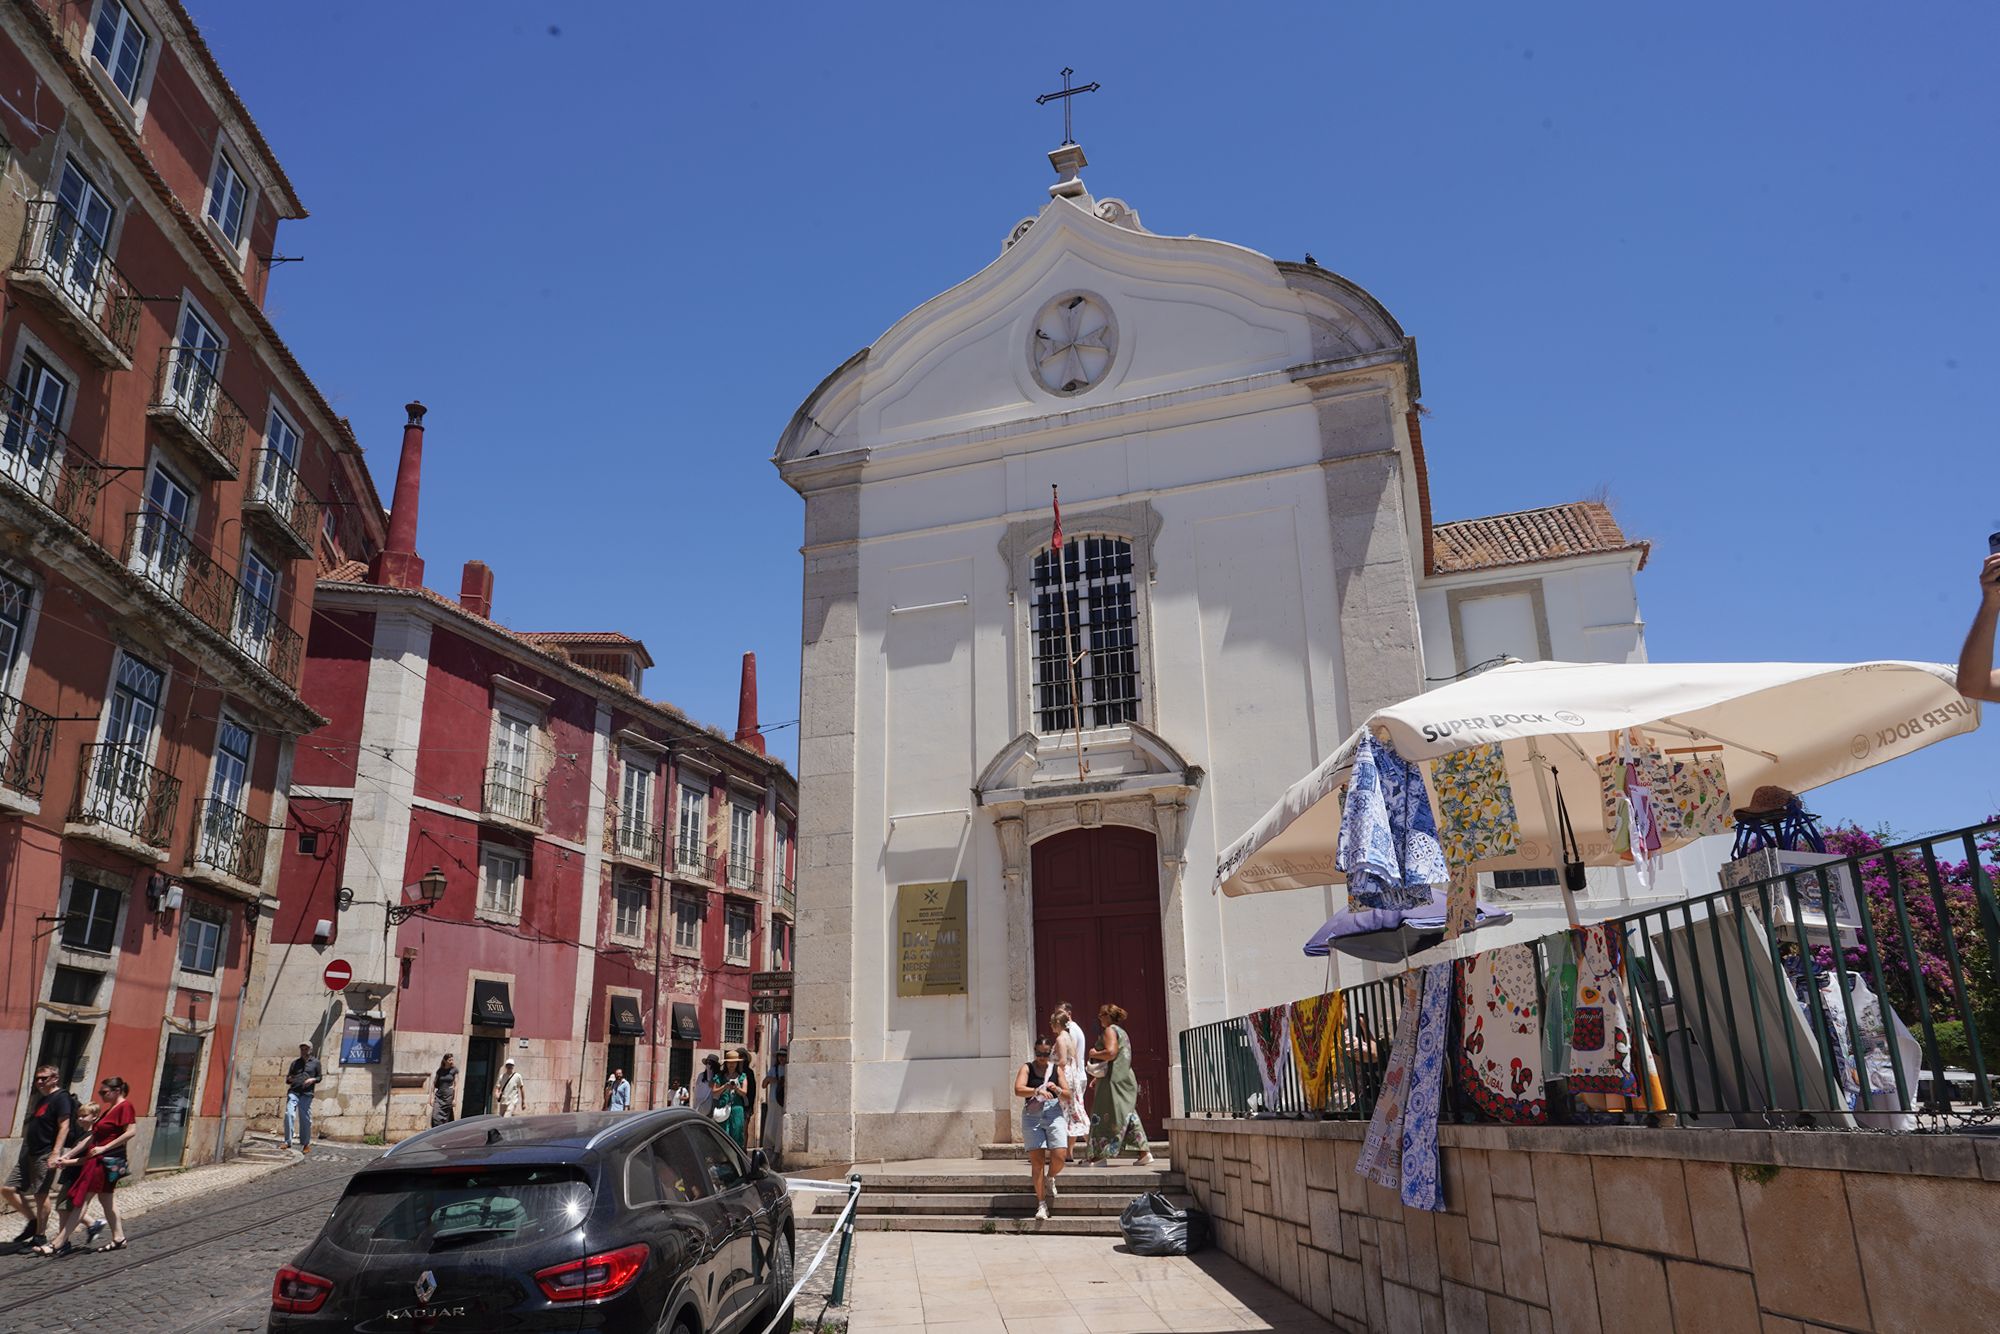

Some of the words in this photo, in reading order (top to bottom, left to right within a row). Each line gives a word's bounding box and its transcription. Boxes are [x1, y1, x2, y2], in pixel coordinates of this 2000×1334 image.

[1422, 716, 1489, 743] SUPER
[1490, 713, 1551, 728] BOCK
[487, 1003, 504, 1012] XVIII
[386, 1307, 465, 1319] KADJAR
